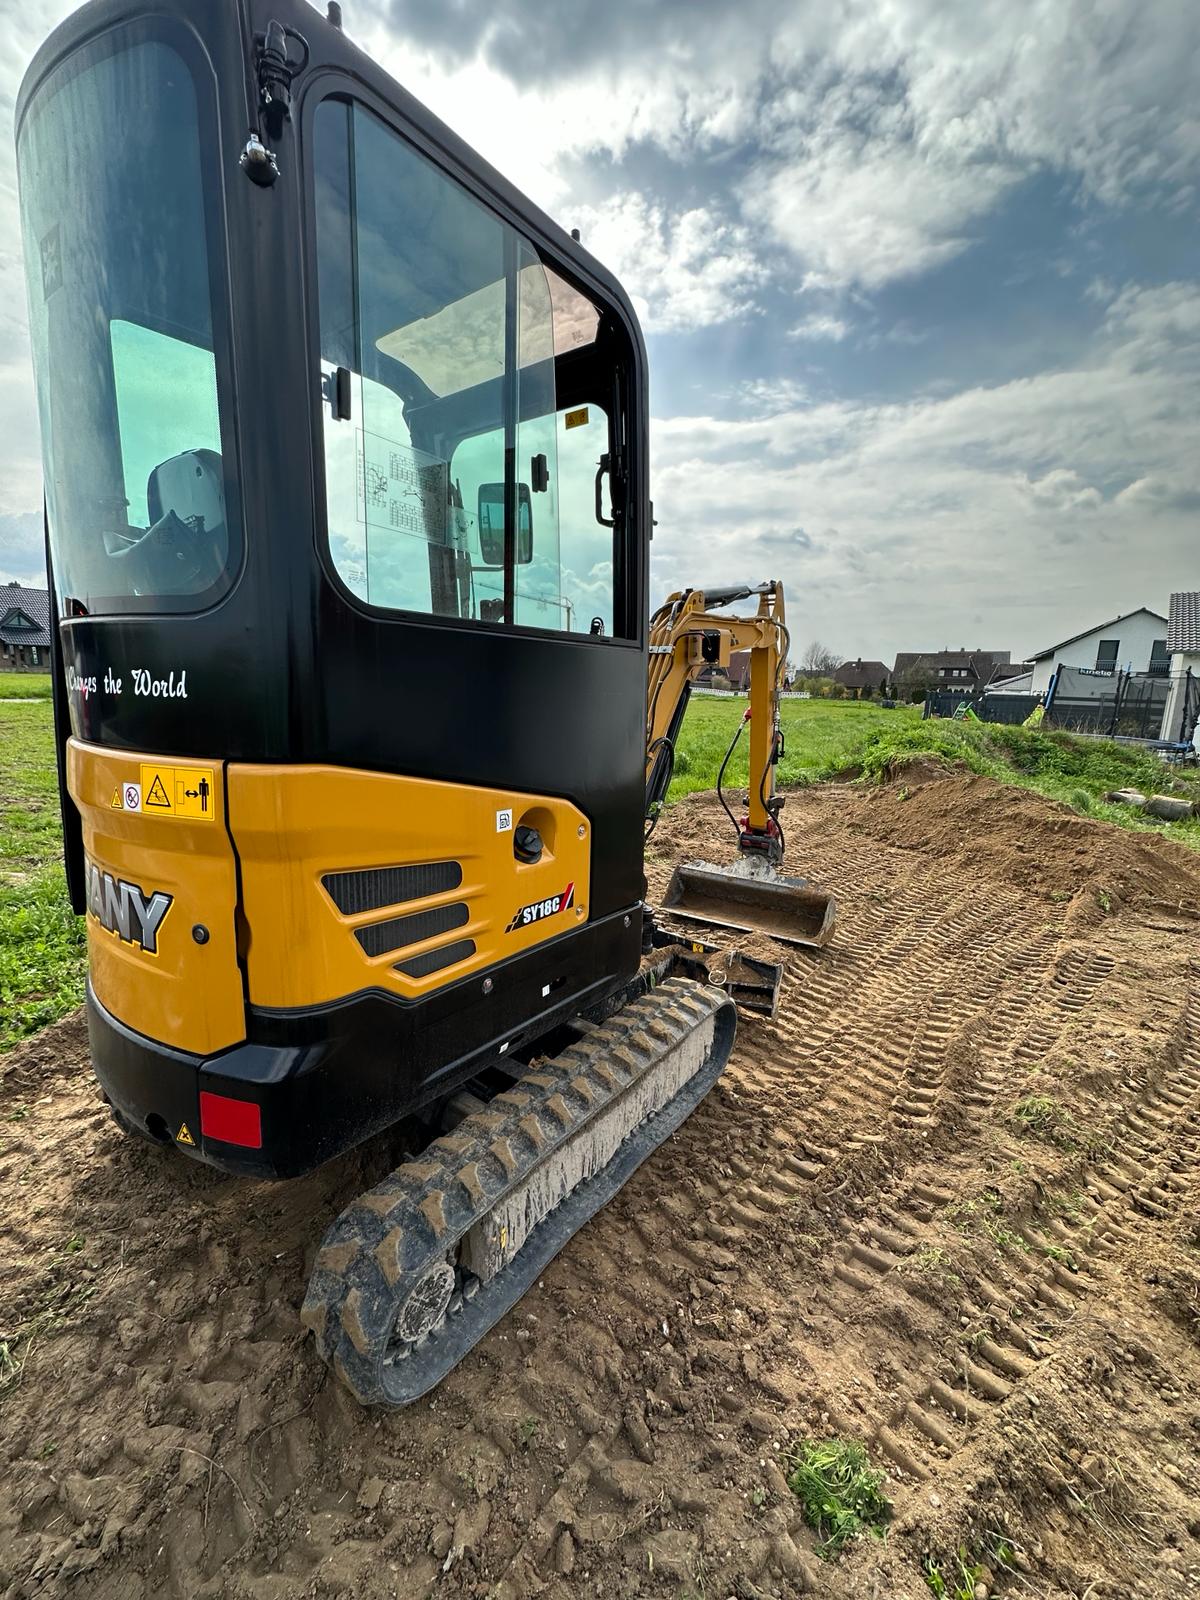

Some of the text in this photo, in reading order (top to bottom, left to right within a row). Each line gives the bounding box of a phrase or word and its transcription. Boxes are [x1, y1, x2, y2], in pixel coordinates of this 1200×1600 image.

[104, 667, 122, 694] the
[131, 669, 188, 698] World
[86, 861, 174, 954] ANY
[522, 897, 560, 923] SY18C
